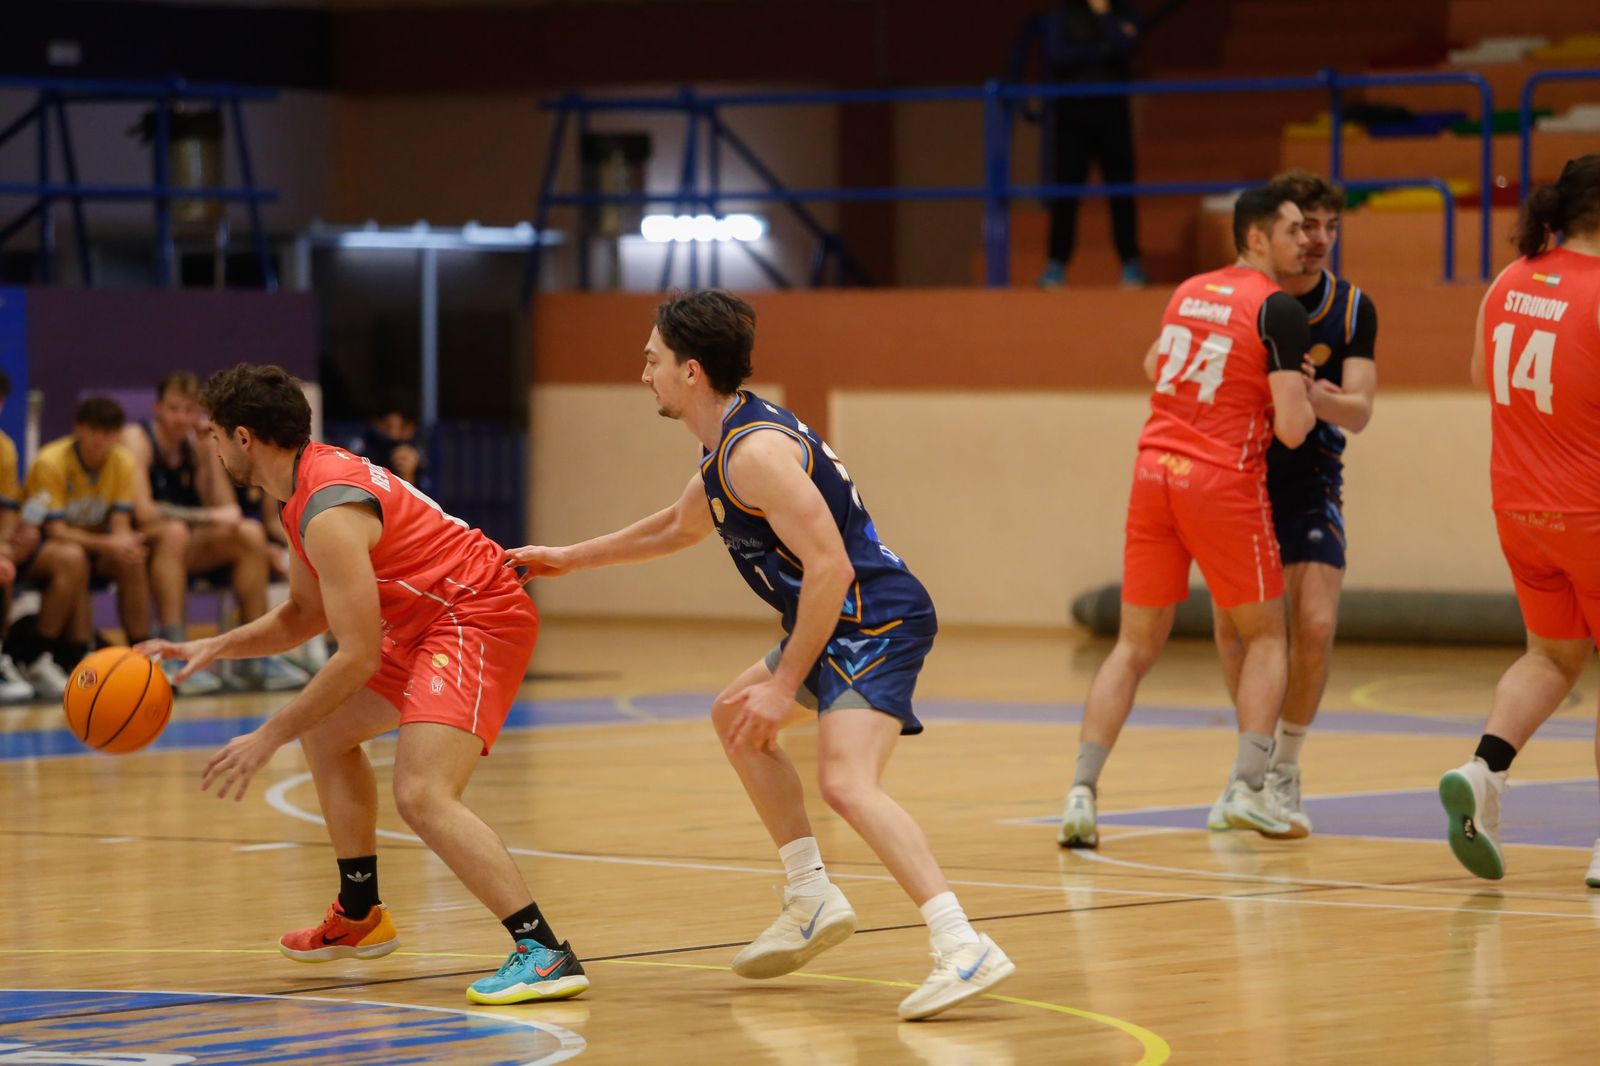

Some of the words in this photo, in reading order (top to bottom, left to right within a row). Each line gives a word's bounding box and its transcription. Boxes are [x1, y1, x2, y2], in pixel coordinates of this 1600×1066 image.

[1504, 289, 1568, 321] STRUKOV
[1155, 323, 1233, 405] 24
[1493, 322, 1557, 415] 14
